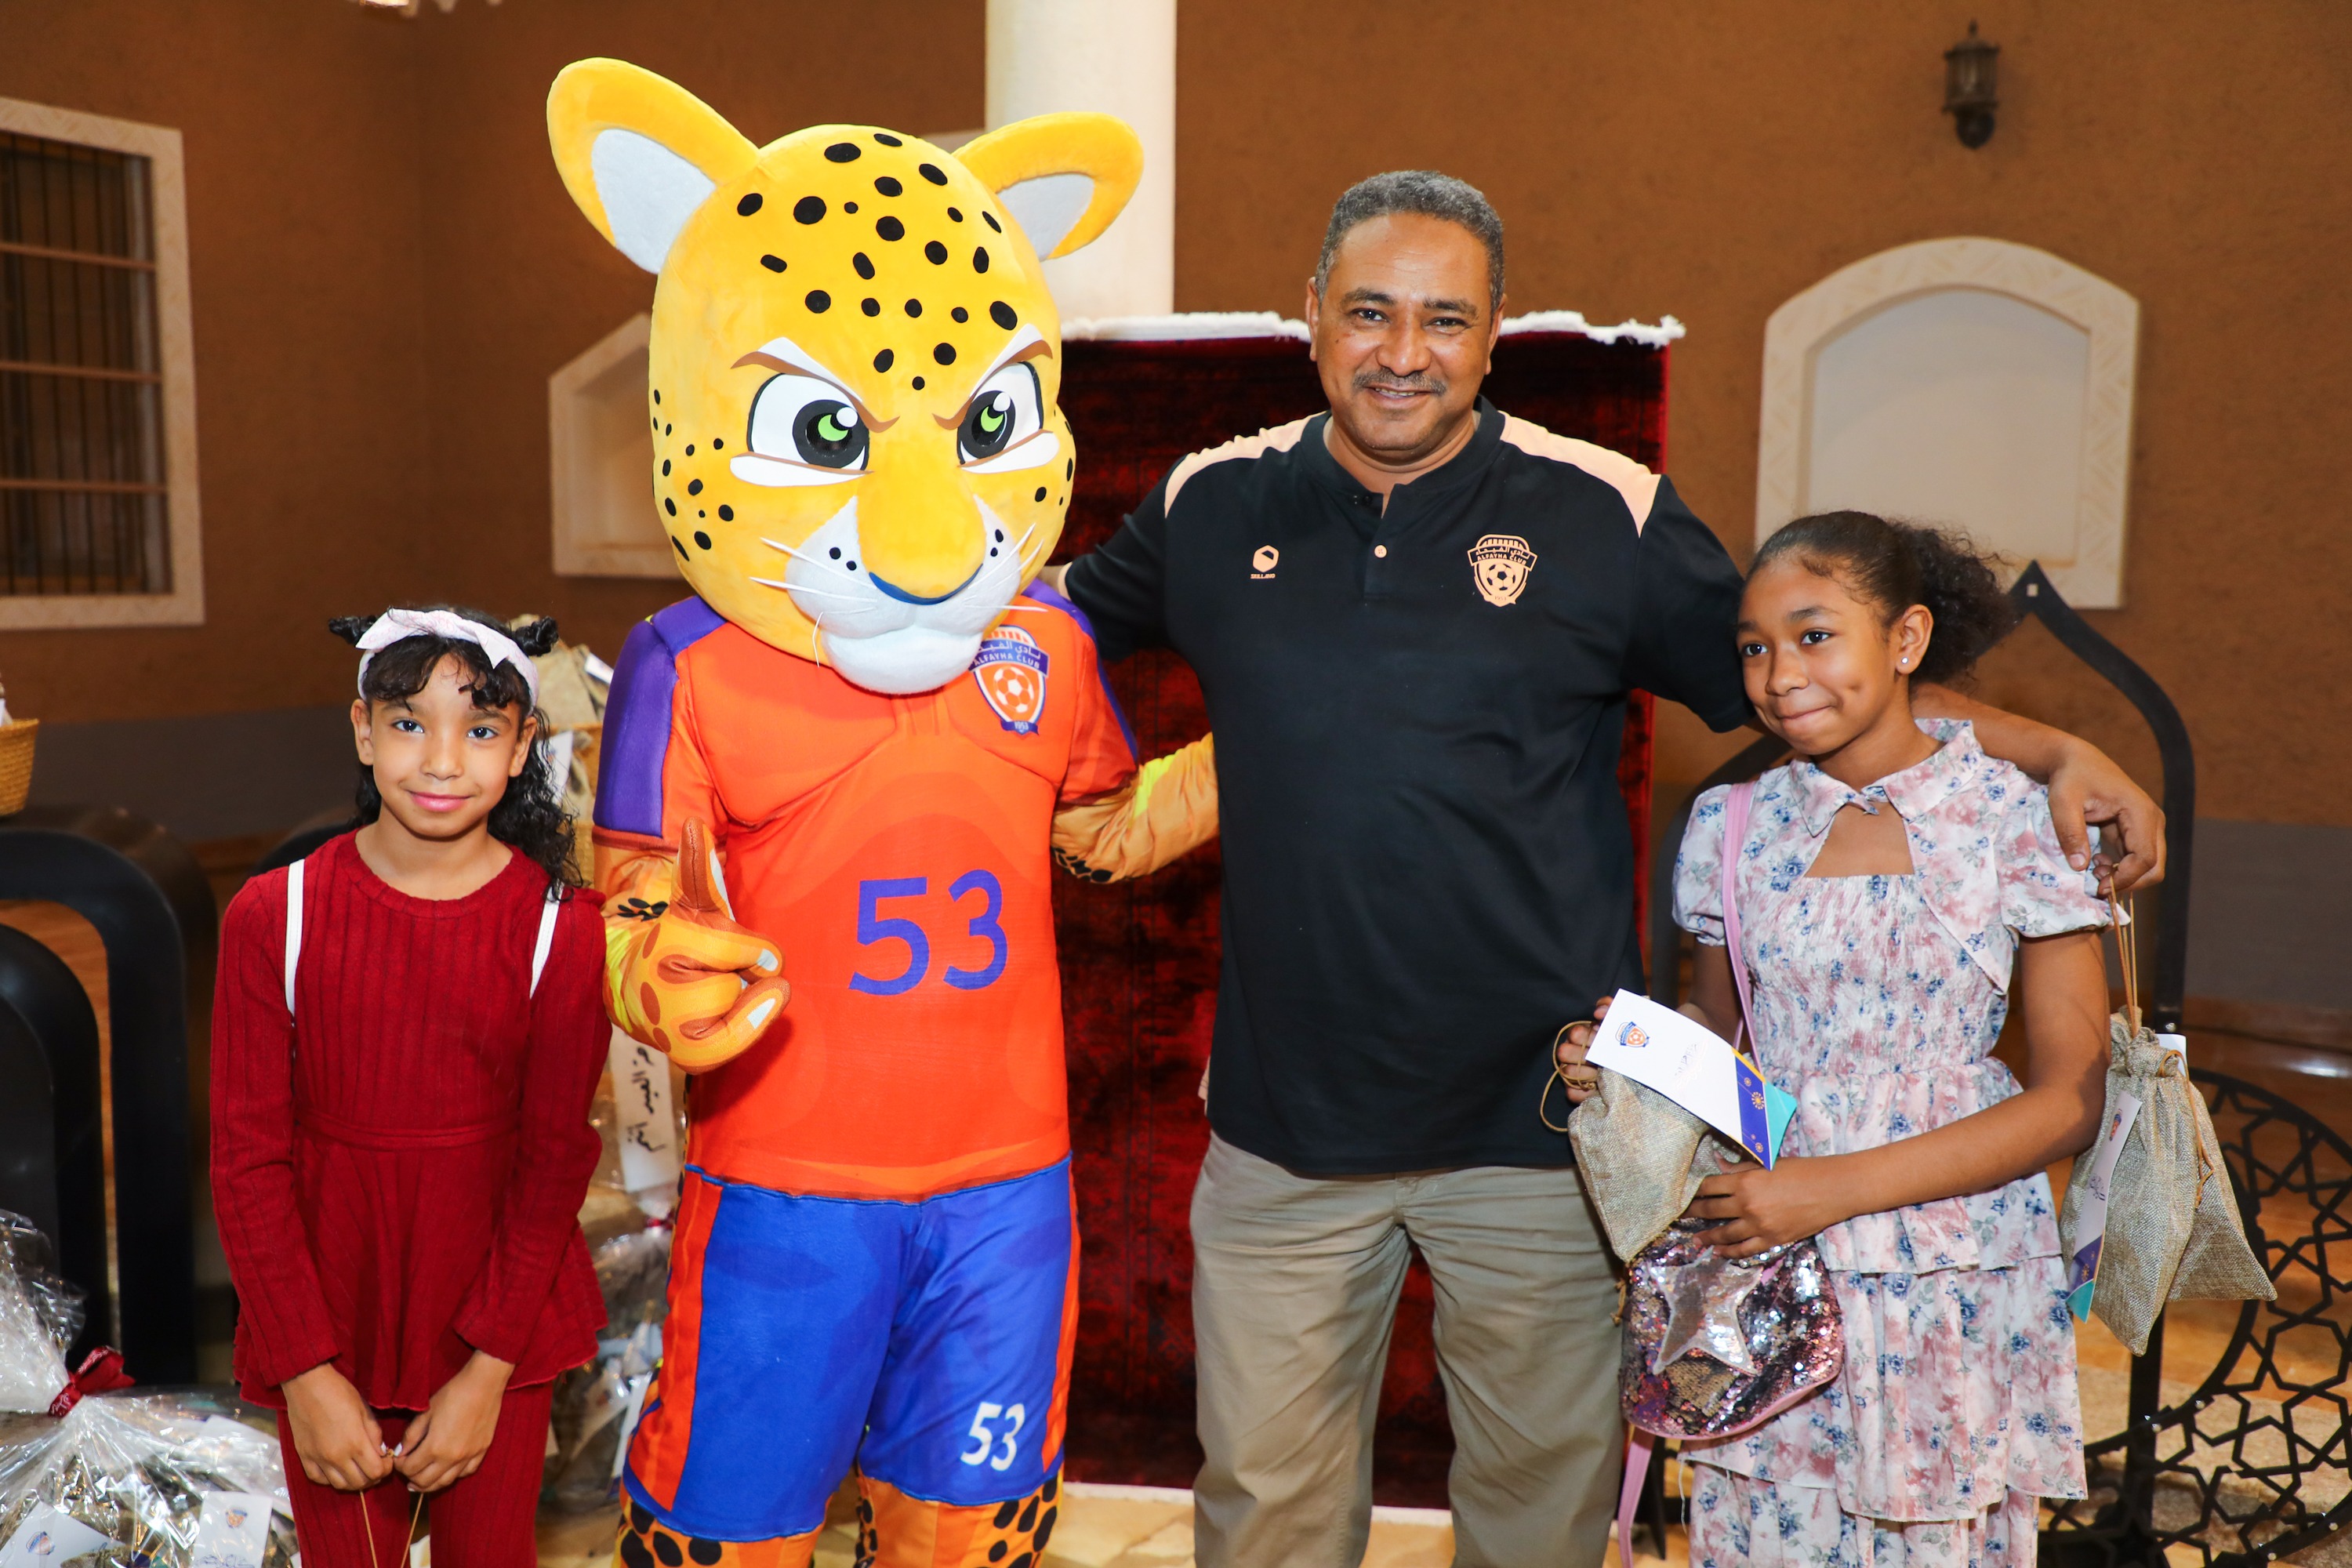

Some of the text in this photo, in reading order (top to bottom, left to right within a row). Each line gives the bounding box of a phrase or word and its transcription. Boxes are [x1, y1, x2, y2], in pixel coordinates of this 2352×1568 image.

[1477, 553, 1527, 565] ALFAYHA CLUB
[974, 652, 1040, 670] ALFAYHA CLUB
[848, 868, 1008, 996] 53
[960, 1400, 1025, 1472] 53
